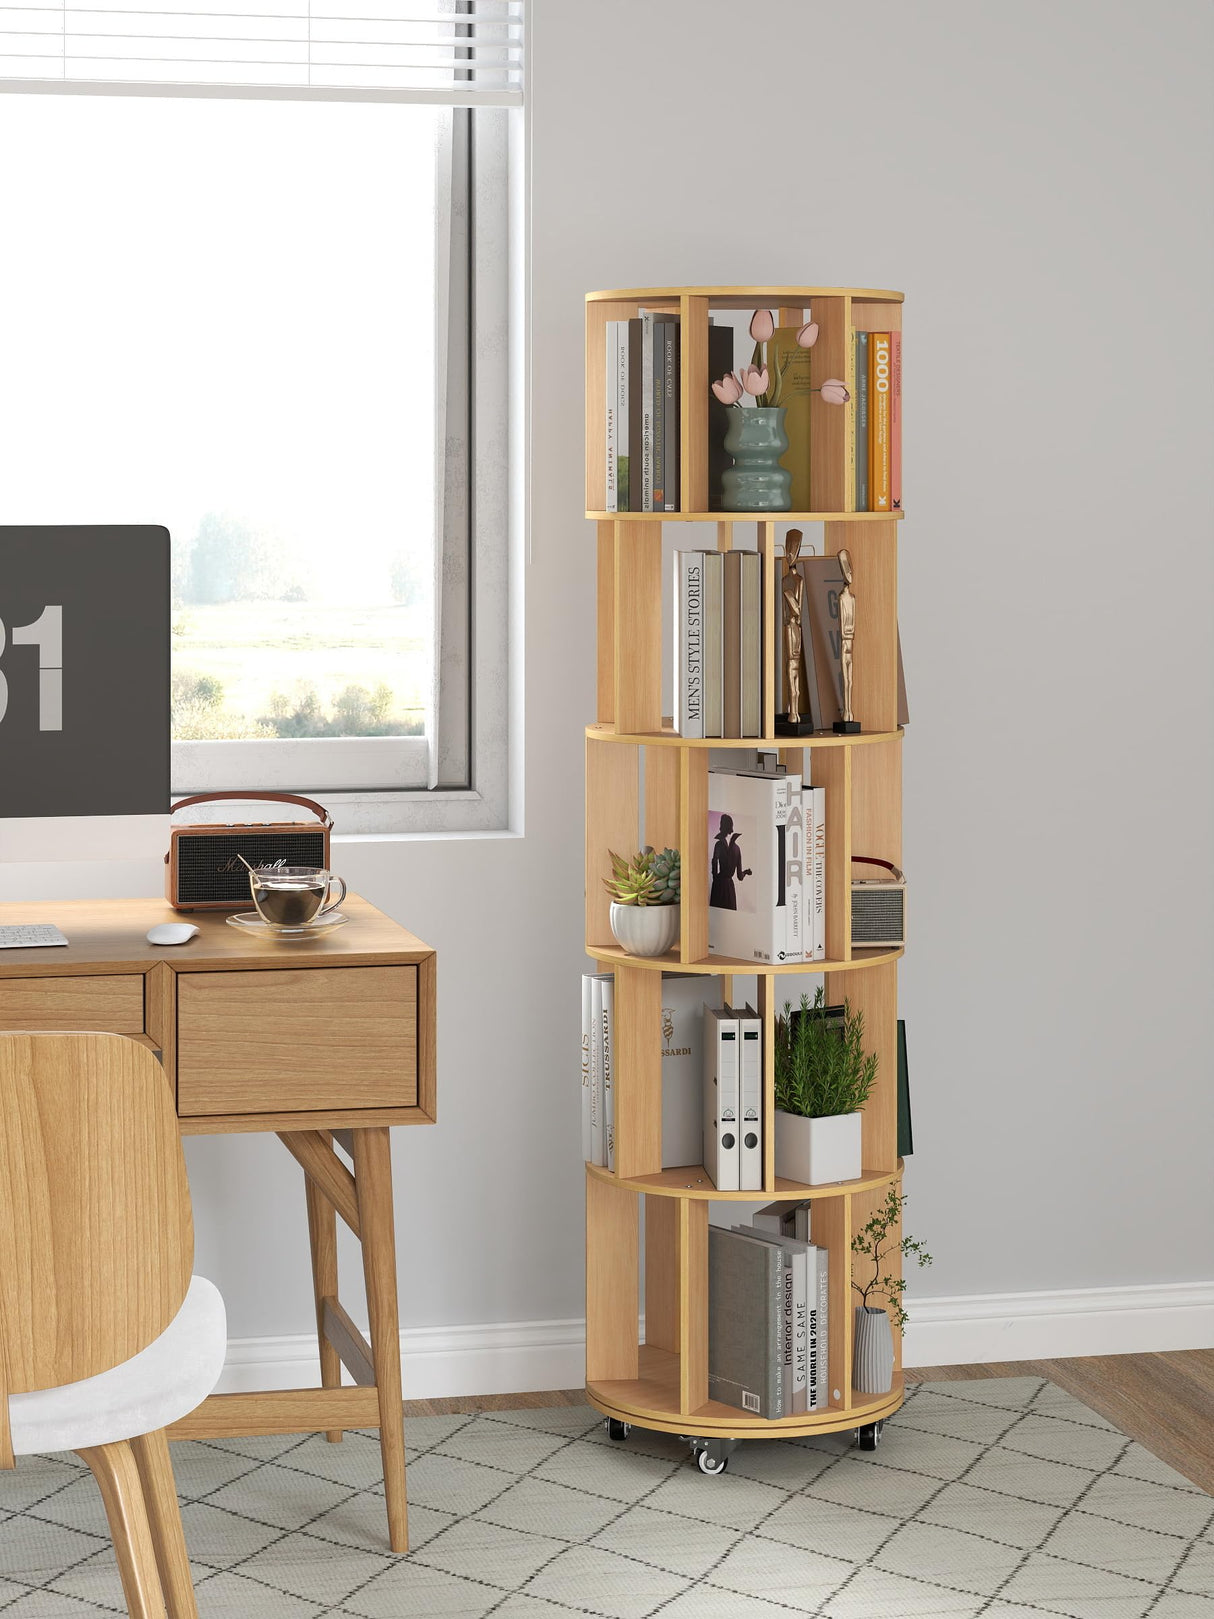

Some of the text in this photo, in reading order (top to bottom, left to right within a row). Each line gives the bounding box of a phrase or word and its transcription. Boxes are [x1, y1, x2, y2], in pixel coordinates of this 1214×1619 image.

[877, 340, 889, 392] 1000
[688, 567, 700, 720] MEN'S STYLE STORIES
[0, 605, 63, 732] 1
[786, 782, 803, 887] HAIR
[806, 847, 812, 855] IN
[815, 823, 824, 859] VOGUE
[217, 857, 286, 872] Mashall
[776, 1292, 782, 1300] in
[784, 1274, 792, 1366] Interior design
[797, 1302, 806, 1382] SAME SAME
[810, 1338, 817, 1348] IN
[776, 1387, 782, 1396] to
